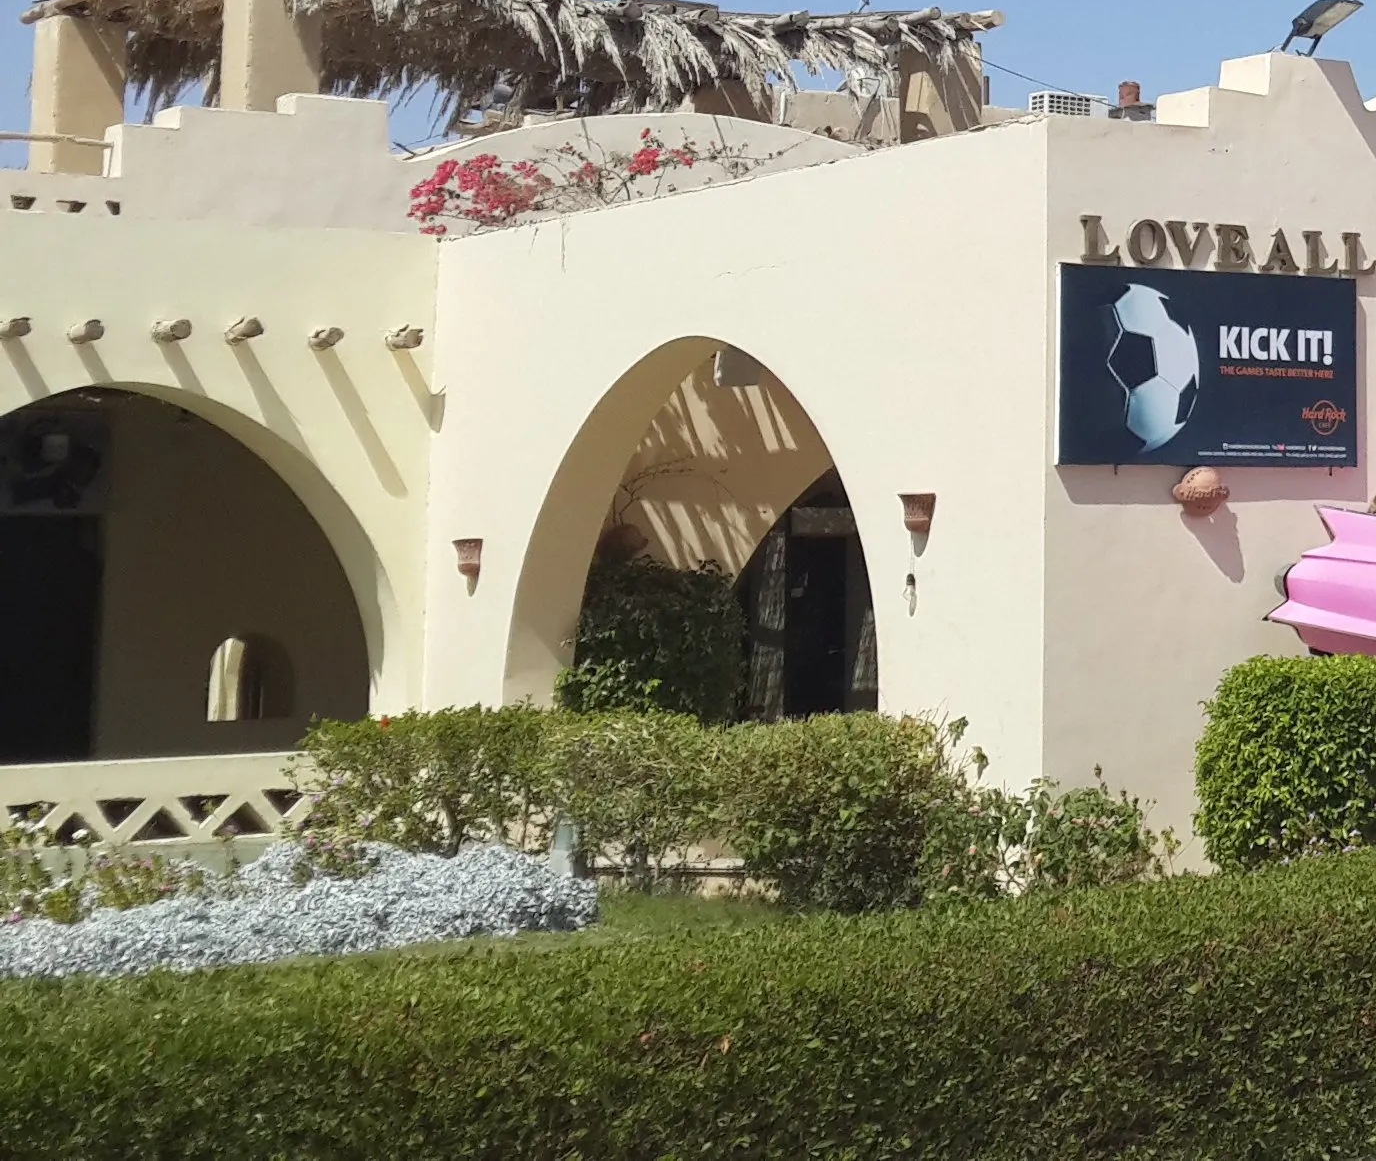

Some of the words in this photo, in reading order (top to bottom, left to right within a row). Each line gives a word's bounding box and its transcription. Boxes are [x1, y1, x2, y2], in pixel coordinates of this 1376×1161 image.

[1219, 325, 1291, 362] KICK
[1298, 329, 1333, 365] IT!
[1302, 407, 1325, 419] Hard
[1325, 408, 1347, 422] Rock
